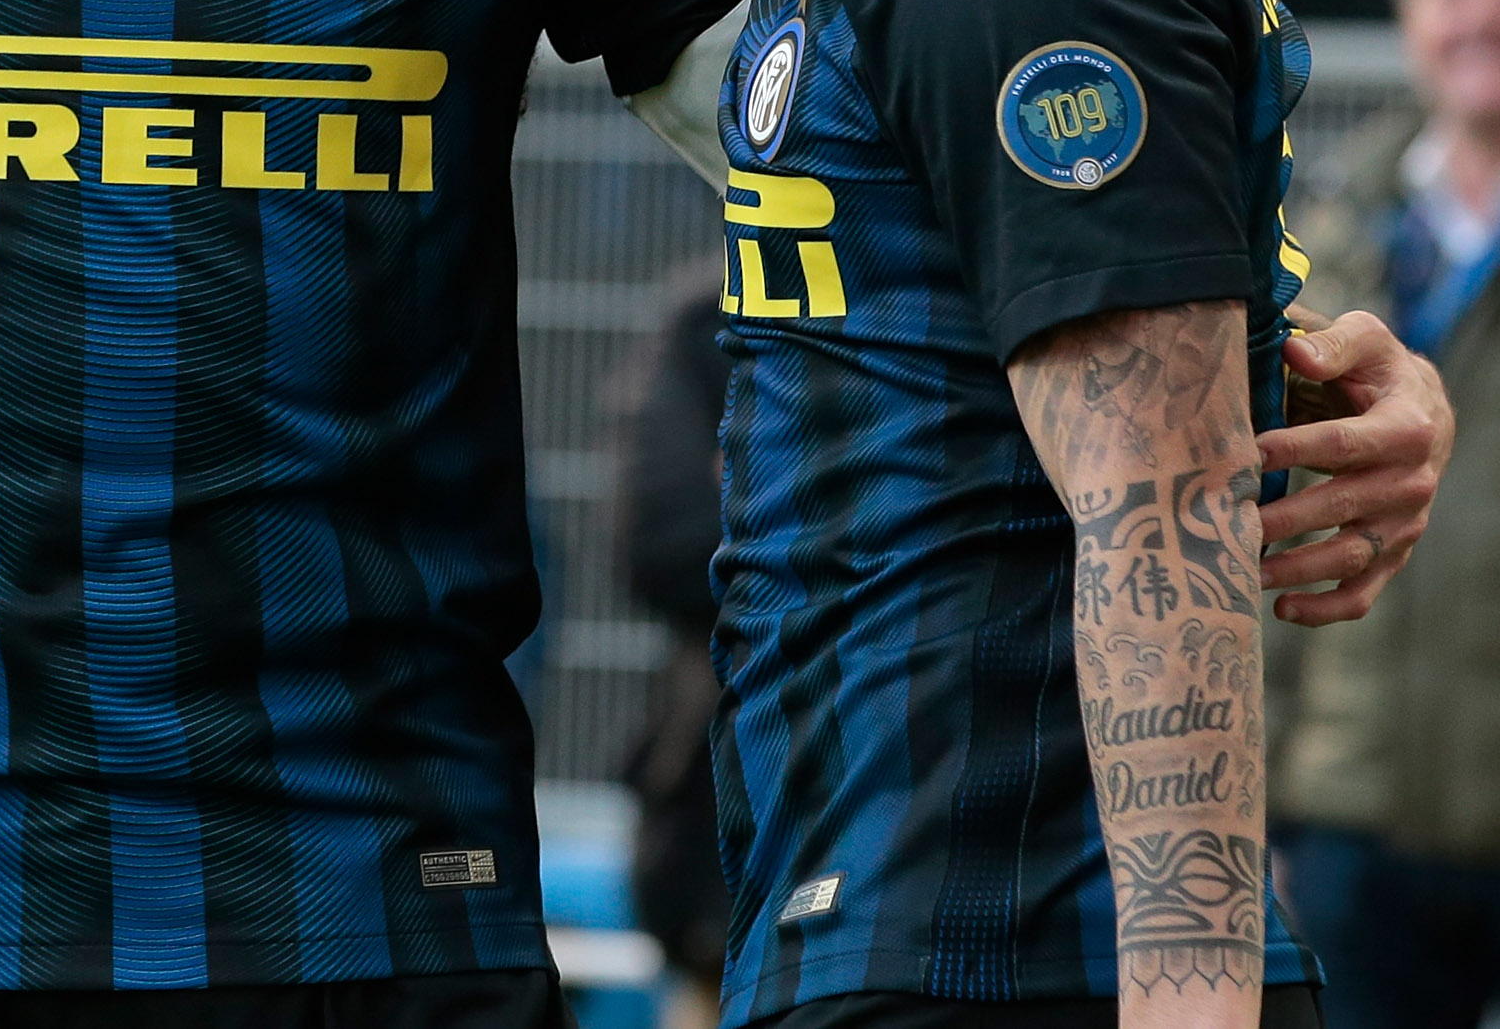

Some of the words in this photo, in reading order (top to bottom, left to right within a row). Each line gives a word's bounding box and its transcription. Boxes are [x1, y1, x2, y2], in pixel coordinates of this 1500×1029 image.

[1012, 60, 1047, 95] FRATELLI
[1050, 54, 1070, 64] DEL
[1074, 55, 1112, 72] MONDO
[1037, 88, 1107, 140] 109
[1084, 685, 1234, 759] Claudia
[1107, 750, 1233, 822] Daniel
